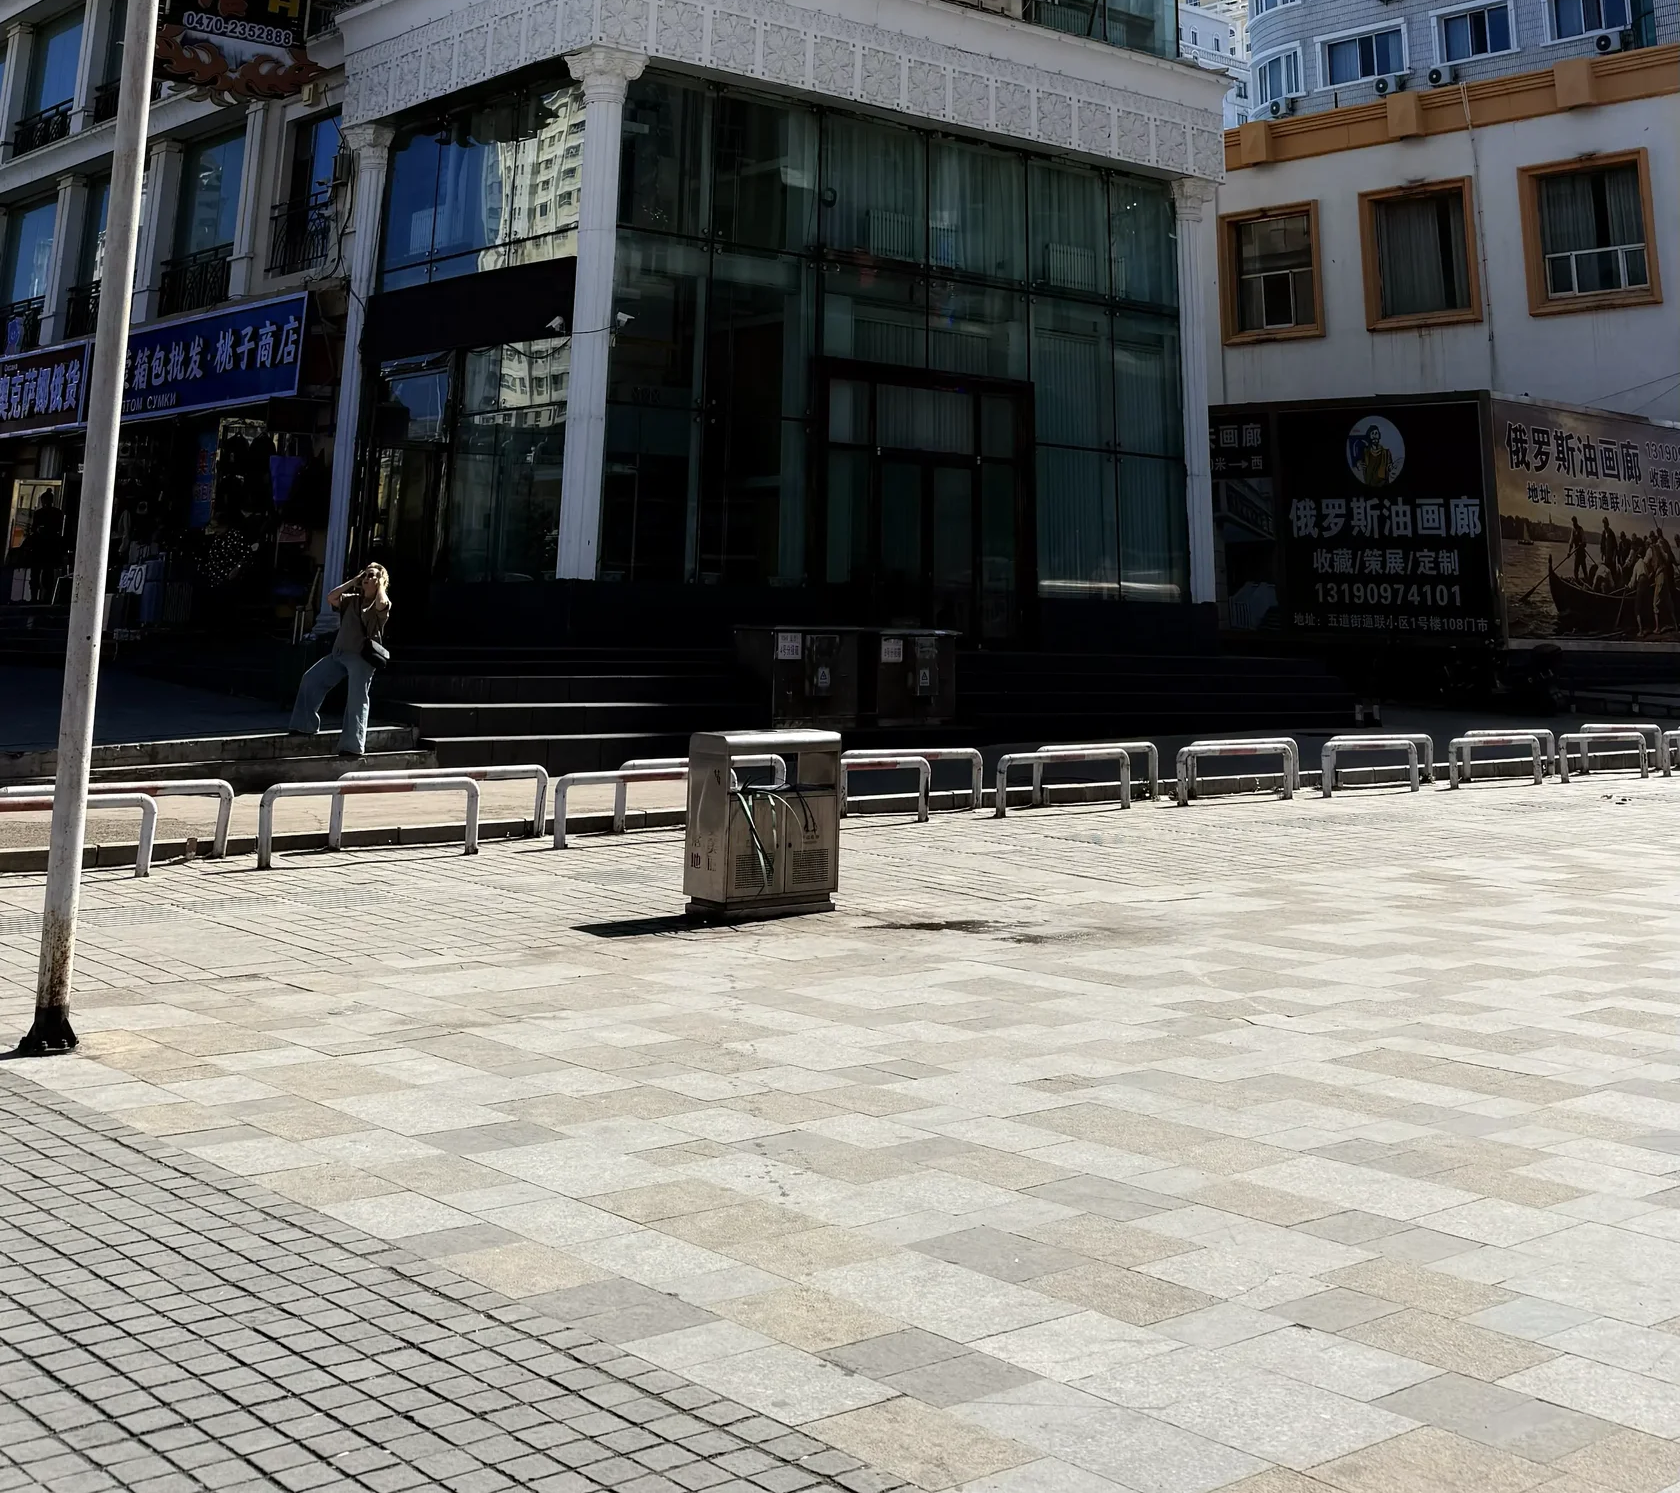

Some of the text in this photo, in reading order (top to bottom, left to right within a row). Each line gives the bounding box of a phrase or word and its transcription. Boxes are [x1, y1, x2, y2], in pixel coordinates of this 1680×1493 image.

[182, 12, 294, 46] 0470-2352888
[147, 391, 177, 410] СУМКИ
[1505, 421, 1642, 484] 俄罗斯油画廊
[1289, 496, 1482, 539] 俄罗斯油画廊
[1313, 548, 1460, 576] 收藏/策展/定制
[1314, 582, 1462, 606] 13190974101
